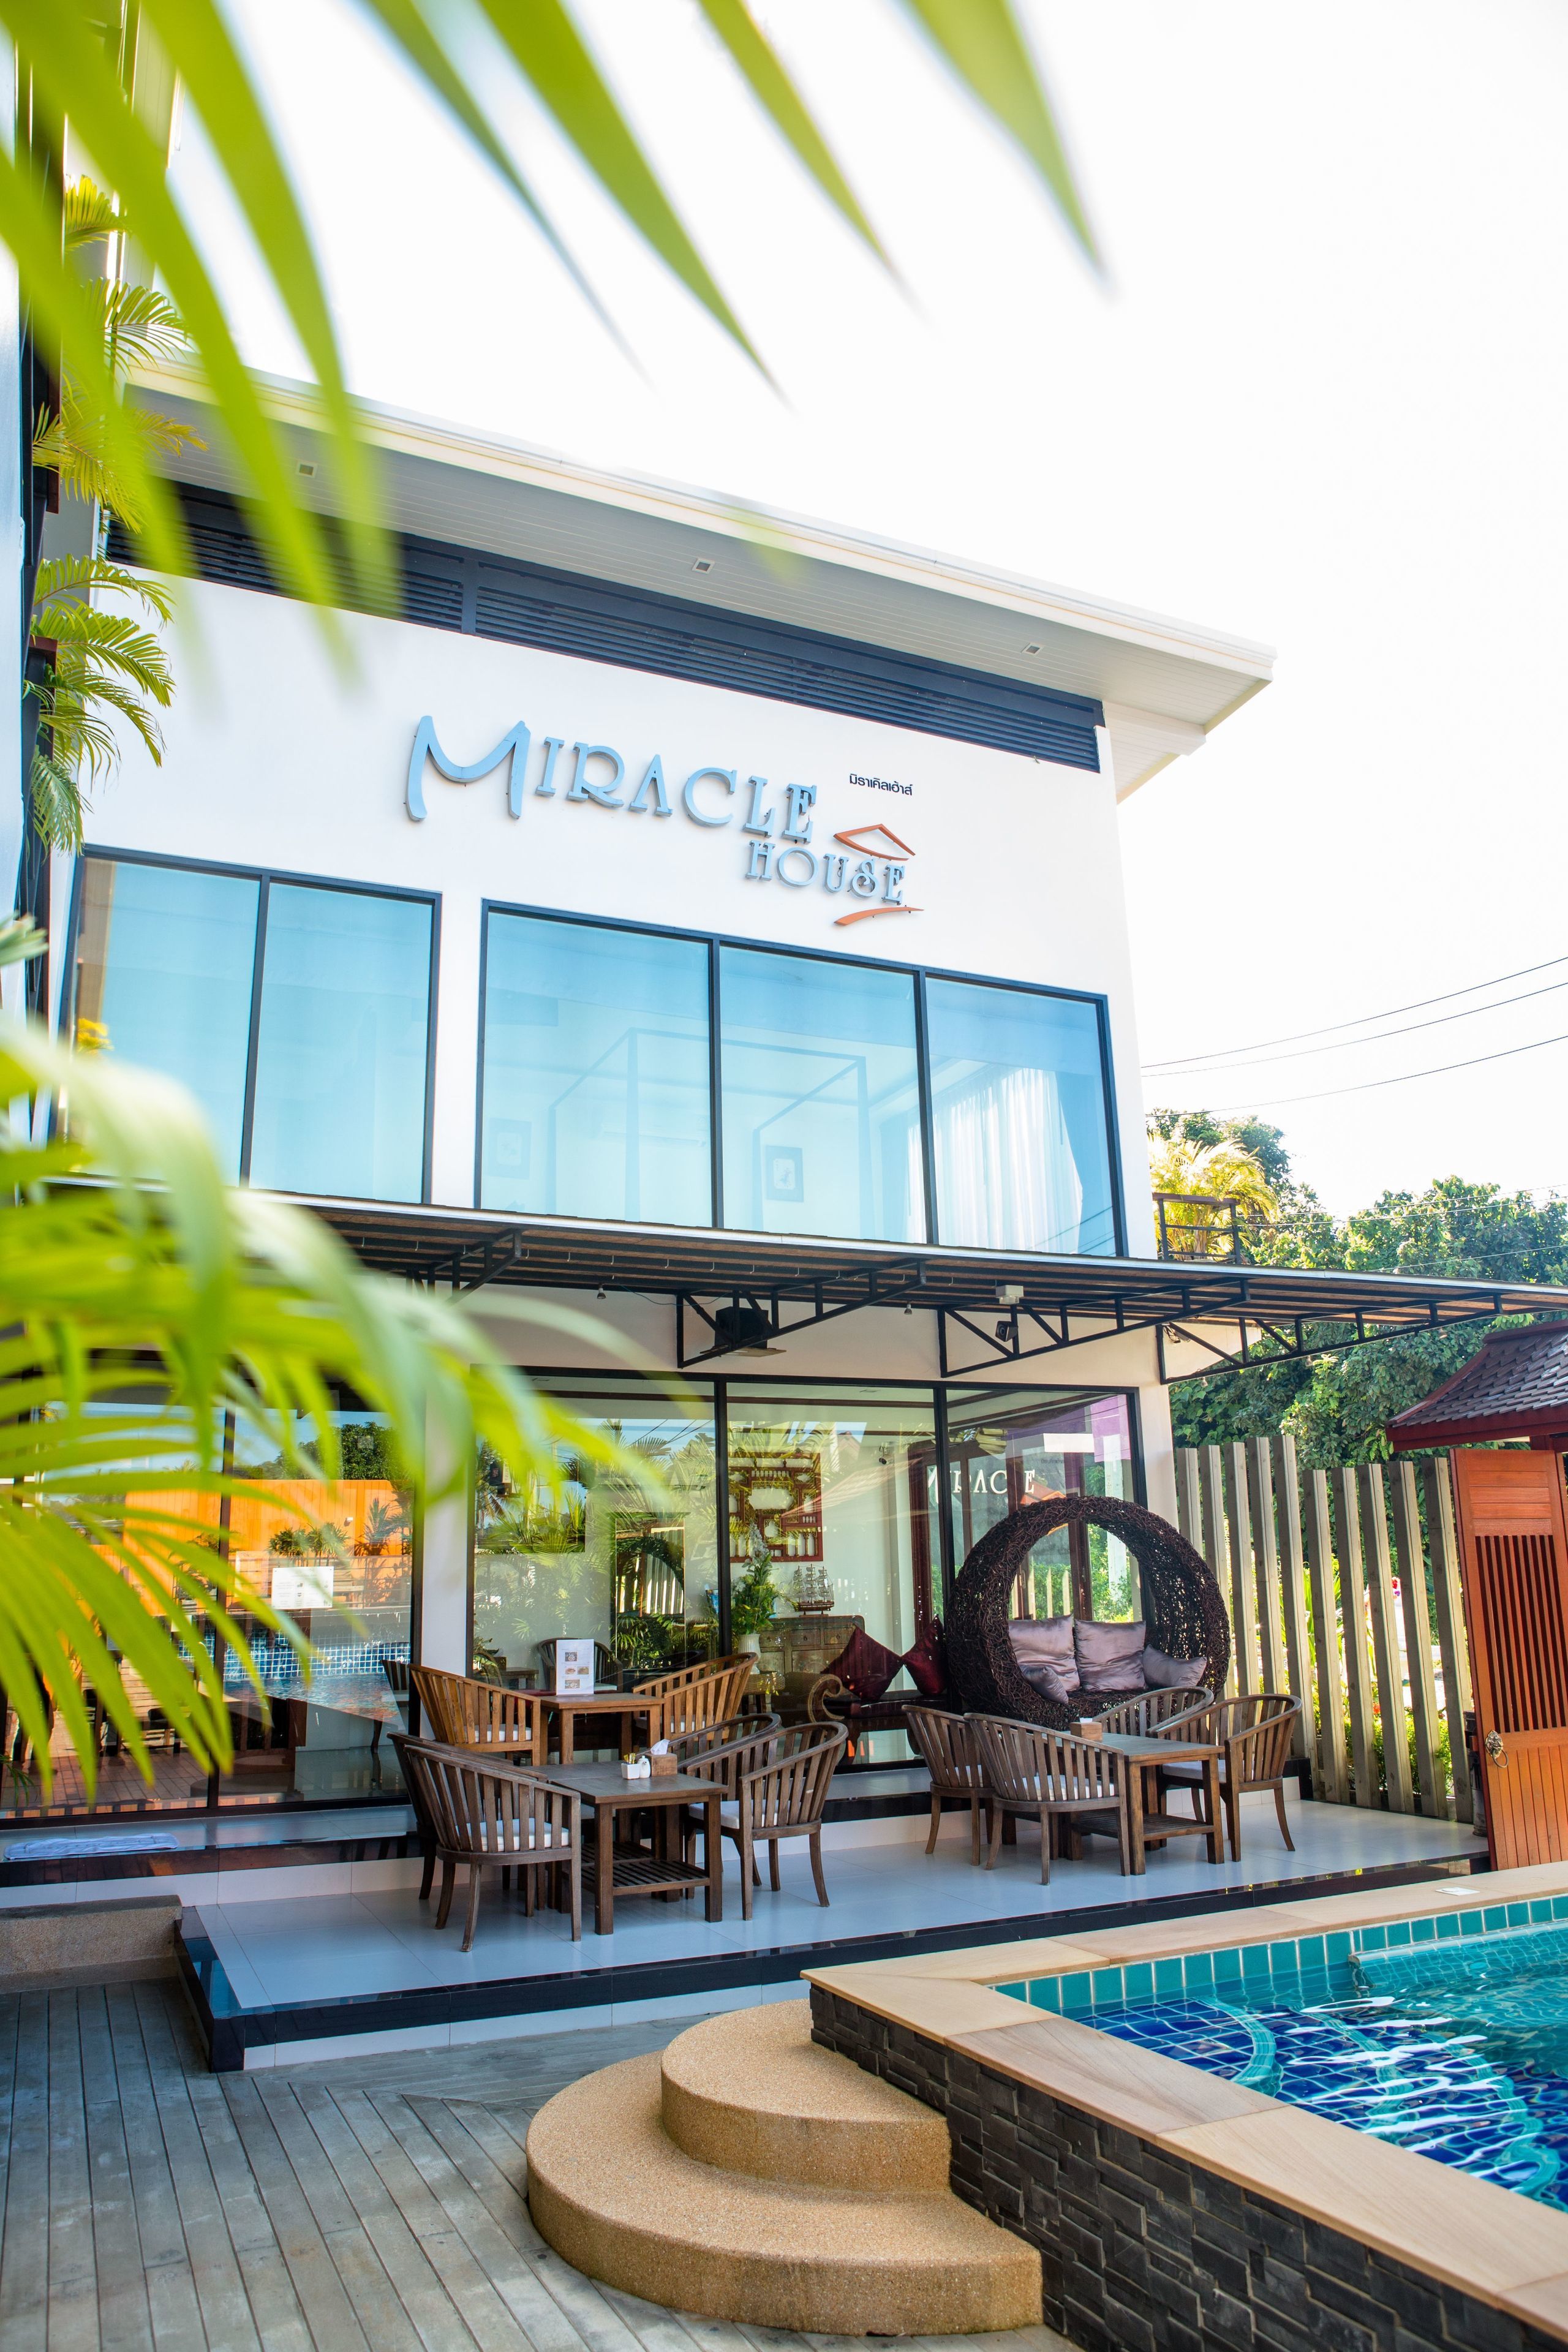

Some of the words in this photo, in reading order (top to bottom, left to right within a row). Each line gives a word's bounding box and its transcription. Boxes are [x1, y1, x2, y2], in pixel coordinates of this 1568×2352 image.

[405, 715, 818, 845] MIRACLE
[849, 773, 913, 796] มิราเคิลเฮ้าส์
[745, 840, 906, 905] HOUSE
